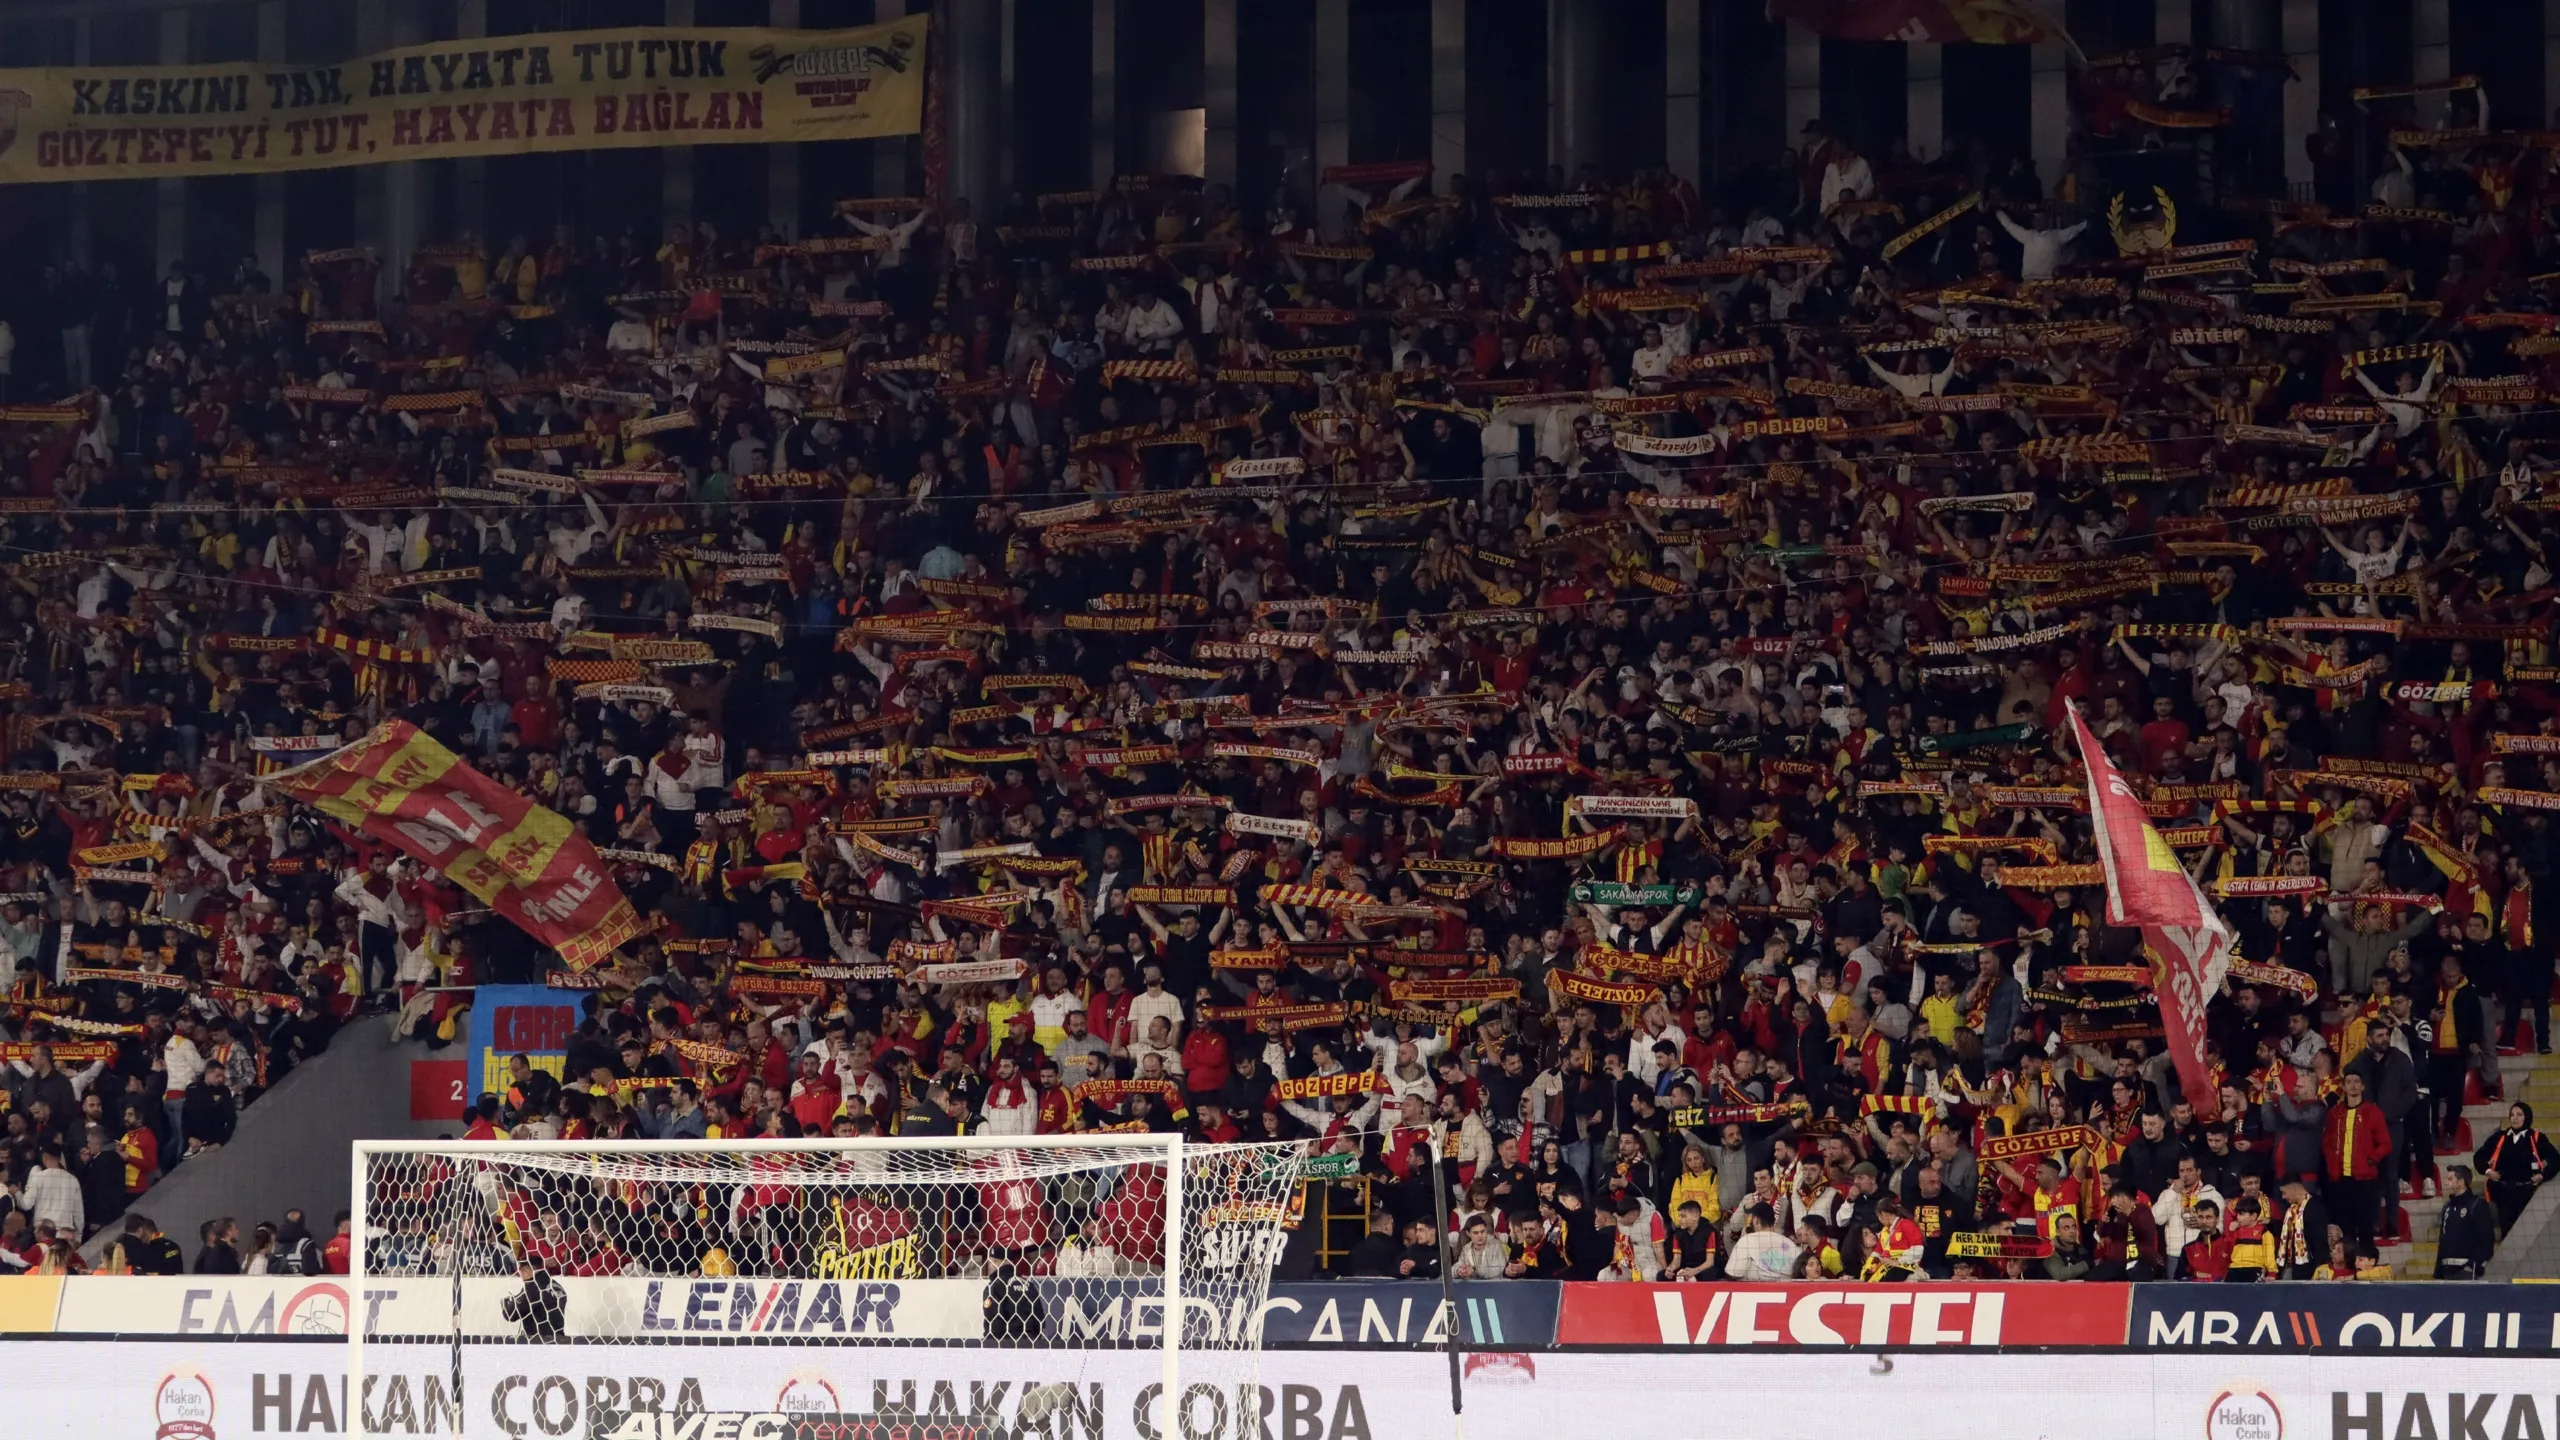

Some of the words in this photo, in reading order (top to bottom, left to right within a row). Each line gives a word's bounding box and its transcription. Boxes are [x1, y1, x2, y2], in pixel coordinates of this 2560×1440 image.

[369, 47, 553, 102] HAYATA
[287, 119, 377, 161] TUT,
[393, 98, 576, 147] HAYATA
[450, 1080, 463, 1101] 2
[1955, 1232, 1972, 1243] HER
[1961, 1245, 1982, 1257] HEP
[252, 1373, 463, 1436] HAKAN
[2218, 1408, 2265, 1425] Hakan
